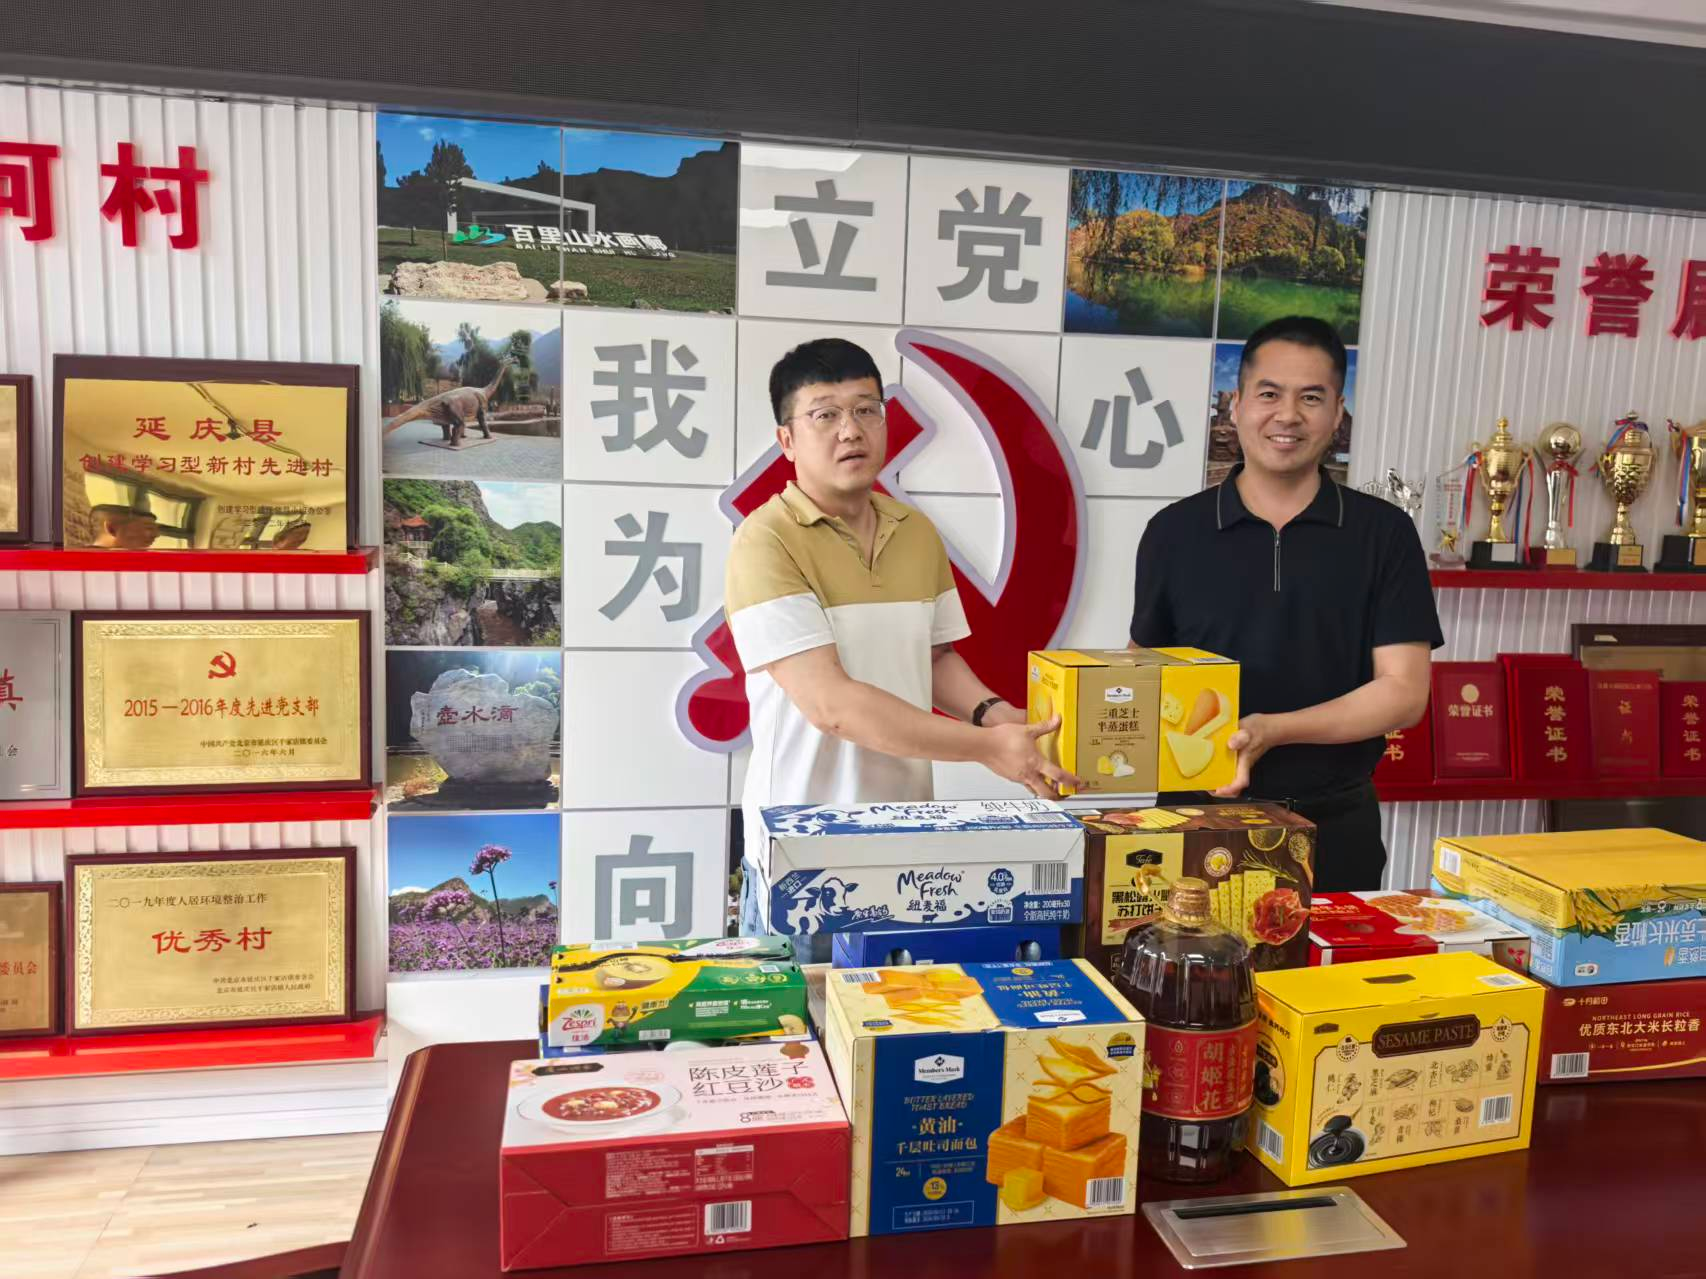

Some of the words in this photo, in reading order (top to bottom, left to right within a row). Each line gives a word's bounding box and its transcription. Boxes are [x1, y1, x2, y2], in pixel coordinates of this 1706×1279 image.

[505, 224, 669, 251] 百里山水画廊
[591, 339, 706, 459] 我
[133, 416, 283, 443] 延庆县
[1080, 367, 1185, 469] 心
[79, 453, 334, 477] 创建学习型新村先进村
[598, 511, 703, 622] 为
[1448, 704, 1494, 719] 荣誉证书
[1544, 685, 1568, 763] 荣誉证书
[1681, 693, 1702, 762] 荣誉证书
[595, 834, 694, 941] 向
[897, 866, 962, 895] Meadow
[920, 881, 959, 900] Fresh
[152, 926, 273, 955] 优秀村
[561, 1017, 596, 1031] Zespri
[1579, 1018, 1700, 1037] 优质东北大米长粒香
[1592, 1014, 1631, 1022] NORTHEAST
[1376, 1029, 1431, 1050] SESAME
[1434, 1023, 1475, 1041] PASTE
[689, 1061, 808, 1082] 陈皮莲子
[1202, 1042, 1224, 1111] 胡姬花
[692, 1077, 783, 1097] 红豆沙
